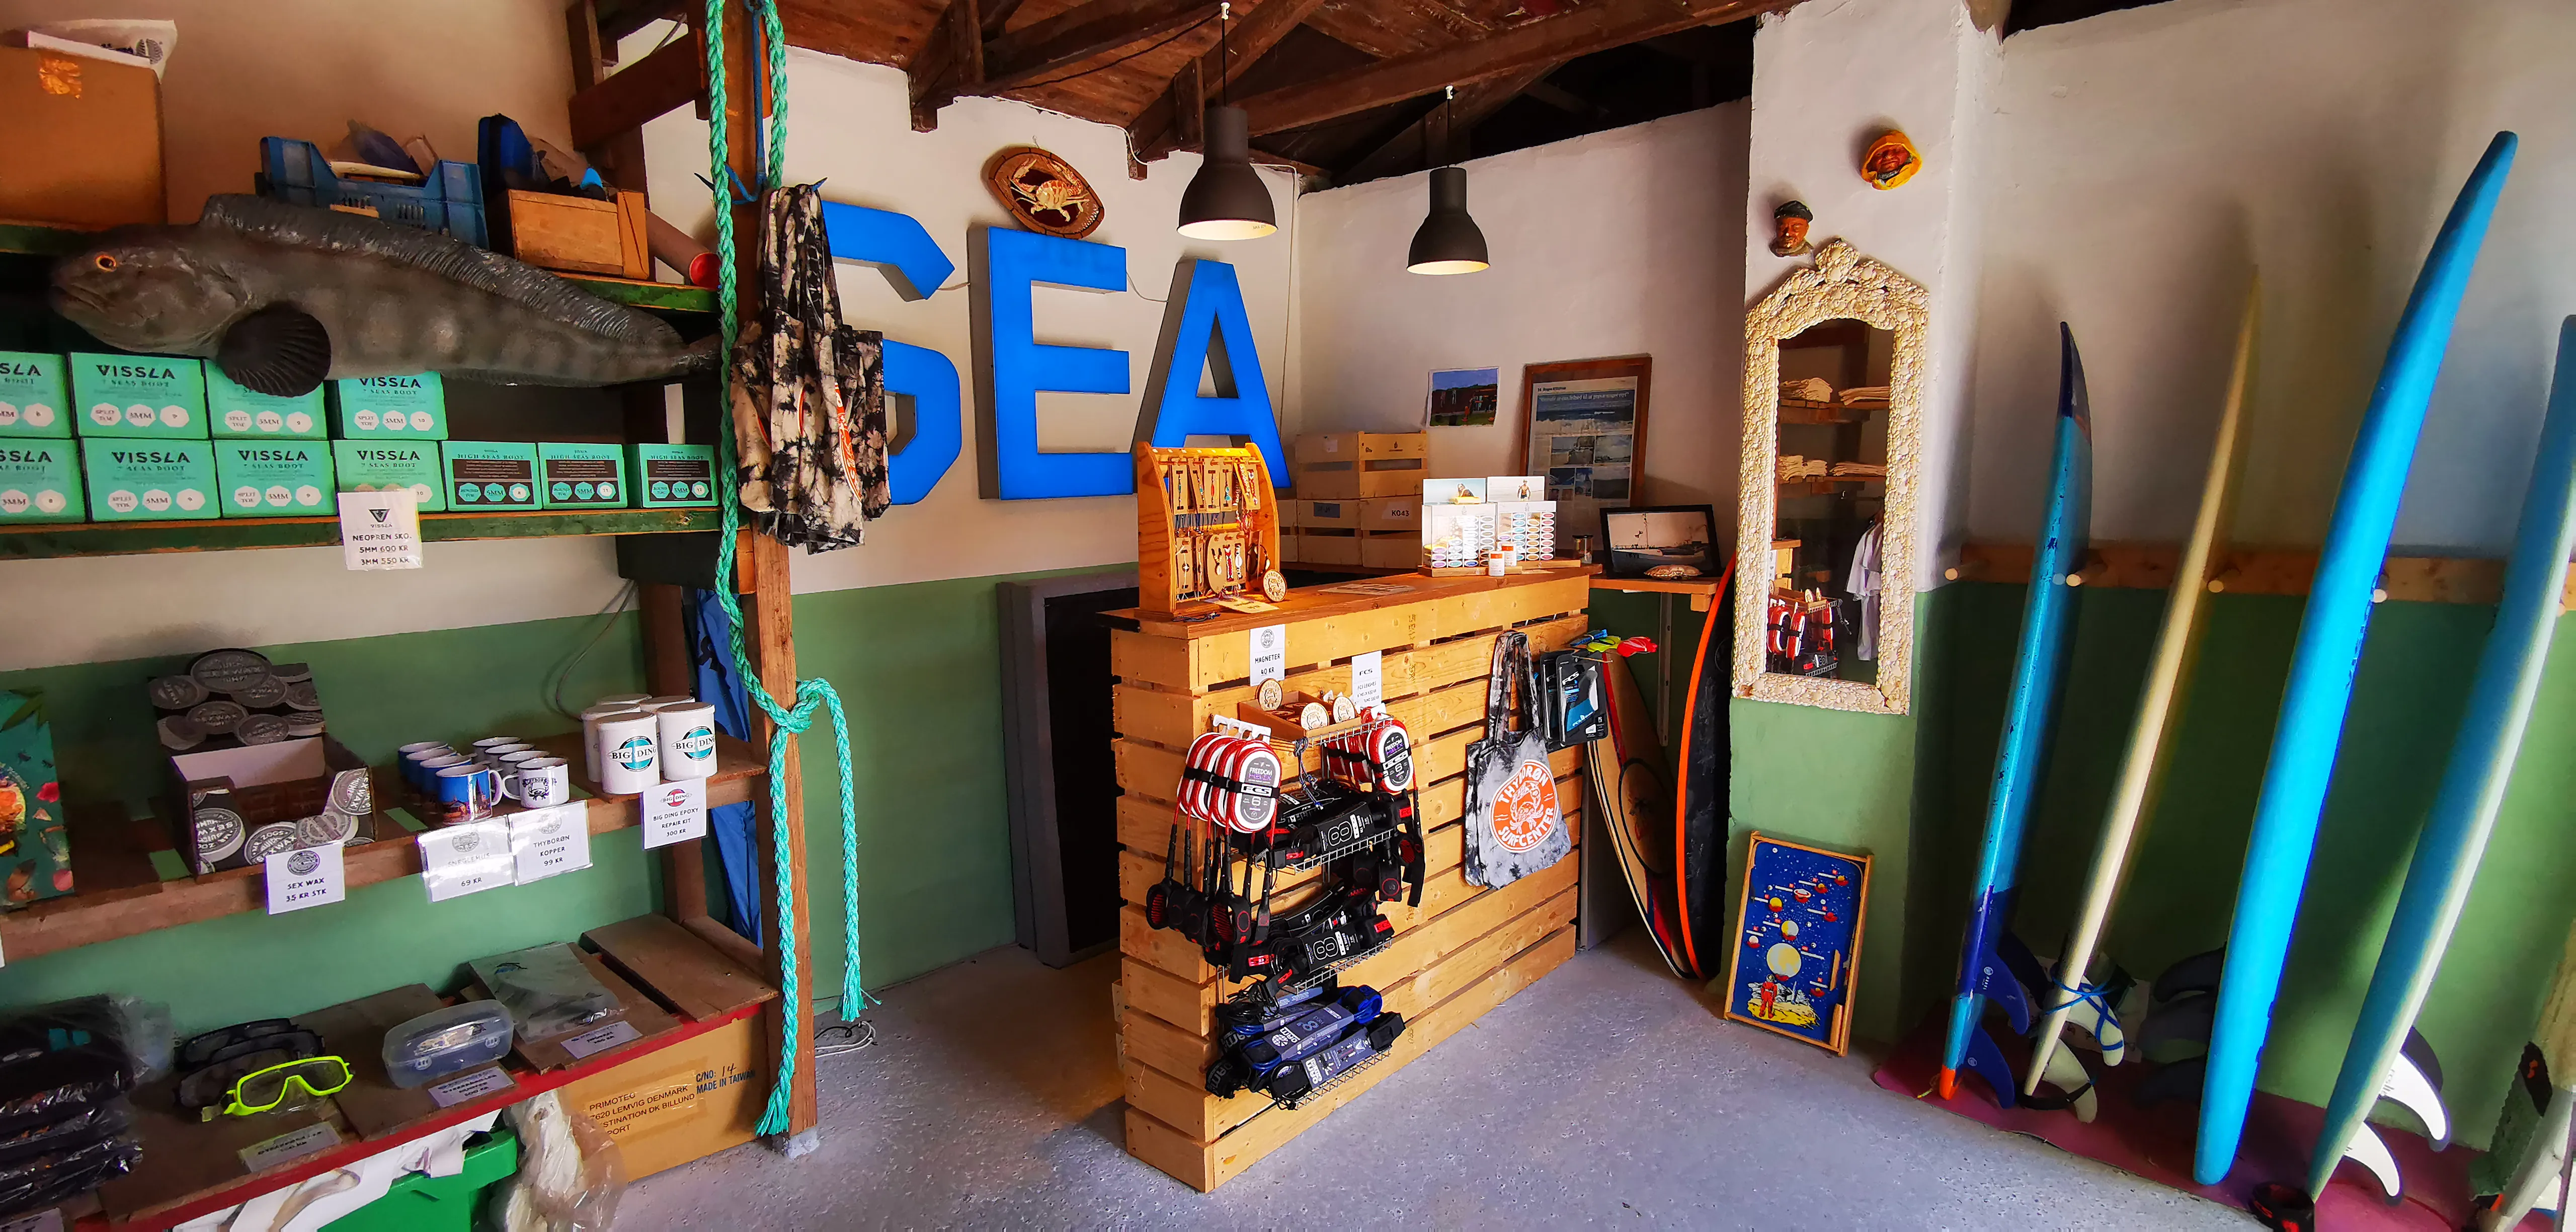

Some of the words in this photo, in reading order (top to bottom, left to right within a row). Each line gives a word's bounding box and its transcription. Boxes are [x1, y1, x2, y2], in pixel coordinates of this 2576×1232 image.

[0, 363, 41, 376] SLA
[96, 364, 176, 379] VISSLA
[359, 377, 422, 389] VISSLA
[112, 451, 191, 464] VISSLA
[237, 450, 309, 462] VISSLA
[357, 450, 421, 461] VISSLA
[1255, 653, 1280, 664] MAGNETER
[1562, 671, 1580, 685] FCS
[1385, 738, 1403, 752] FREEDOM
[612, 752, 631, 760] BIG
[637, 746, 657, 757] DING
[1249, 767, 1273, 776] FREEDOM
[1395, 762, 1403, 773] 6
[1243, 785, 1270, 795] FCS
[1497, 765, 1549, 804] THYORØN
[1251, 796, 1262, 807] 6
[664, 811, 679, 819] DING
[680, 807, 699, 816] EPOXY
[209, 821, 233, 833] SEX
[662, 821, 682, 829] REPAIR
[1498, 807, 1554, 848] SURFCENTER
[1328, 821, 1352, 846] 8
[275, 834, 297, 851] WAX
[533, 834, 570, 848] THYBORØN
[540, 846, 566, 857] KOPPER
[287, 881, 303, 890] SEX
[305, 877, 325, 886] WAX
[286, 894, 296, 902] 35
[312, 888, 327, 897] STK
[1313, 937, 1339, 960] 8
[722, 1062, 737, 1077] 14
[696, 1080, 717, 1095] MADE
[719, 1077, 727, 1088] IN
[729, 1068, 756, 1085] TAIWAN
[612, 1100, 645, 1115] LEMVIG
[647, 1085, 688, 1104] DENMARK
[601, 1108, 647, 1128] STINATION
[649, 1105, 660, 1114] DK
[662, 1093, 695, 1109] BILLUND
[607, 1124, 631, 1135] PORT
